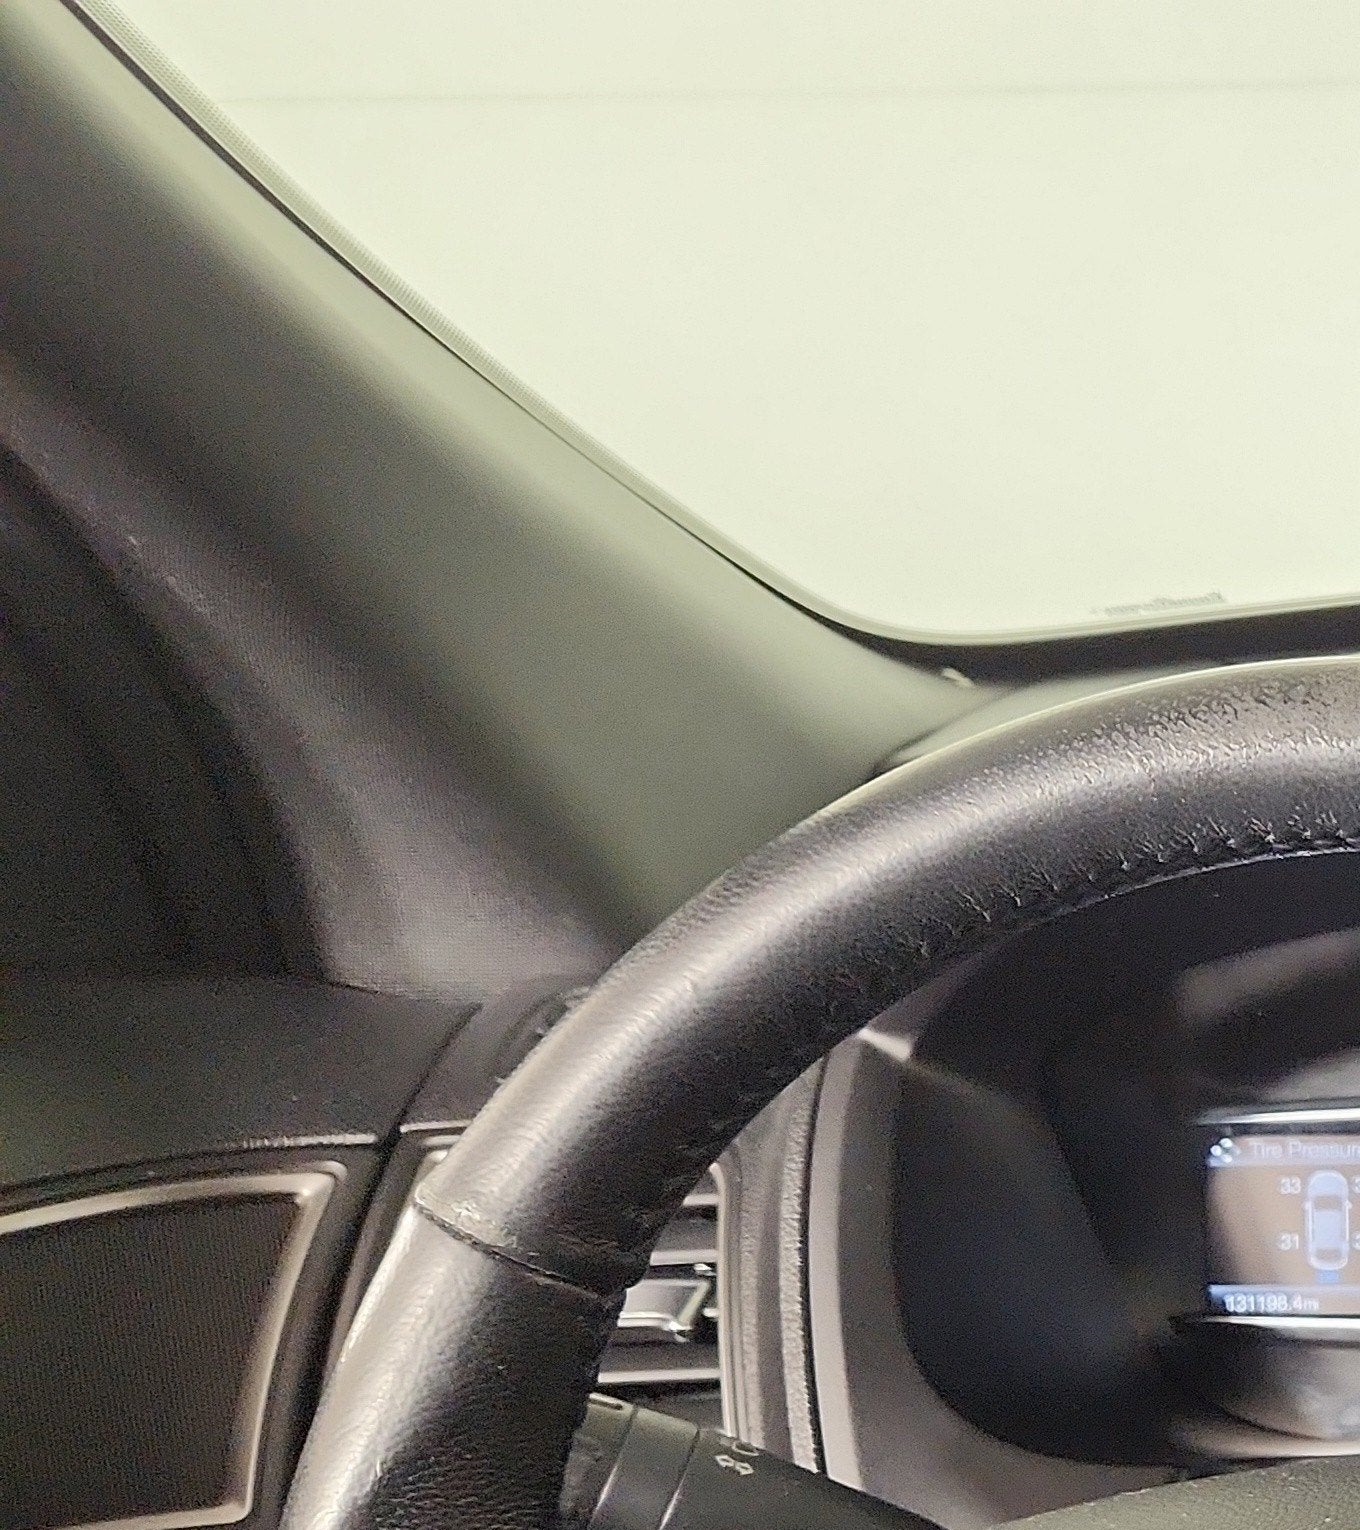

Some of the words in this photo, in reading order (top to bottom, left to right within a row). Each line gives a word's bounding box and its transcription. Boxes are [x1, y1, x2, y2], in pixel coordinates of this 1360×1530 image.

[1250, 1141, 1283, 1159] Tire
[1279, 1178, 1301, 1194] 33
[1279, 1235, 1300, 1251] 31
